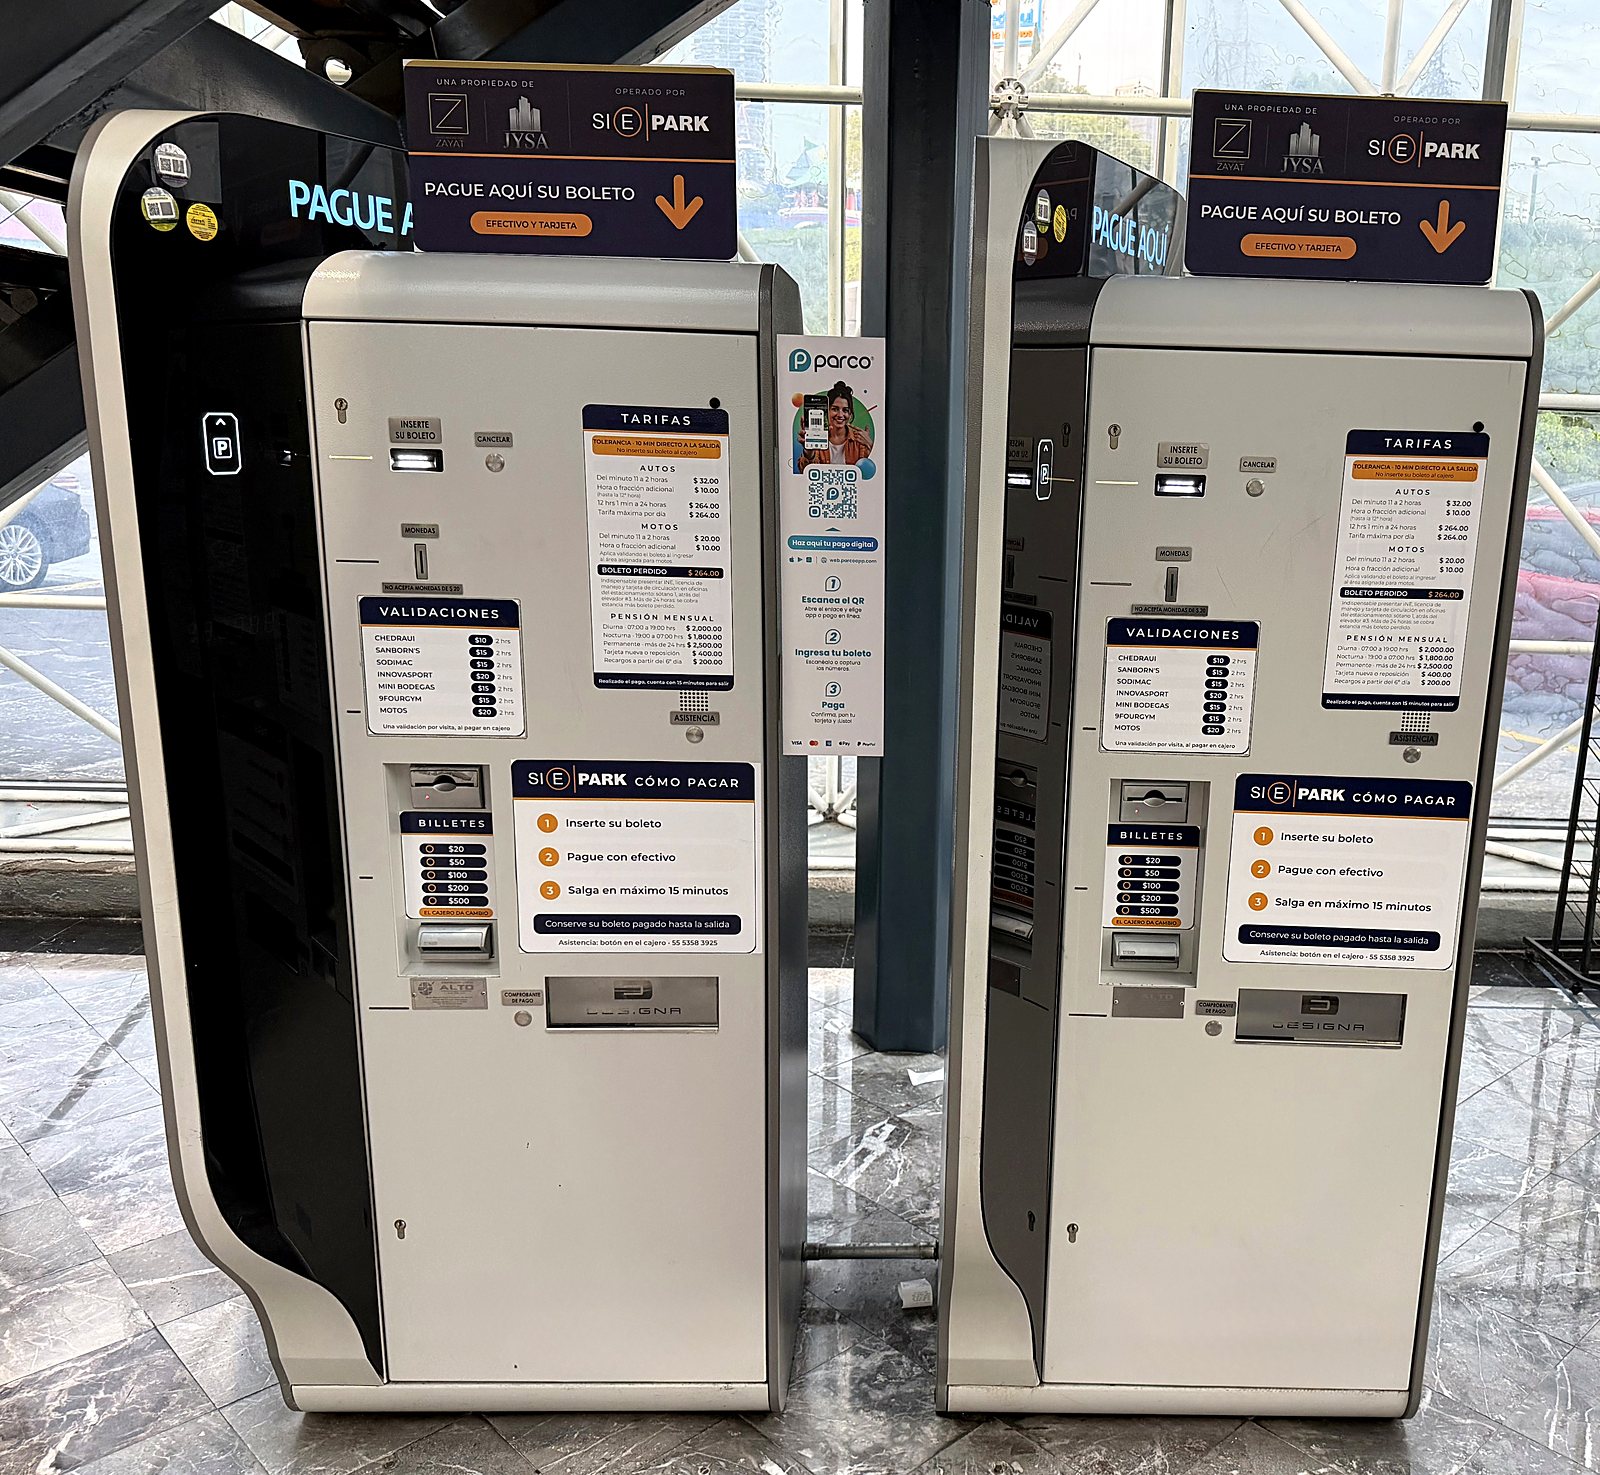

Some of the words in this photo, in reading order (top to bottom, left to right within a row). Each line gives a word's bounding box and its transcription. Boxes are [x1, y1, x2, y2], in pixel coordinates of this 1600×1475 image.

[436, 78, 457, 86] UNA
[461, 79, 517, 88] PROPIEDAD
[615, 88, 662, 96] OPERADO
[1247, 105, 1301, 114] PROPIEDAD
[652, 114, 709, 132] PARK
[1393, 115, 1438, 124] OPERADO
[503, 133, 549, 149] JYSA
[1424, 142, 1481, 160] PARK
[1217, 162, 1244, 171] ZAYAT
[1280, 157, 1324, 174] JYSA
[424, 182, 484, 198] PAGUE
[489, 182, 533, 200] AQUÍ
[537, 185, 560, 198] SU
[565, 186, 635, 200] BOLETO
[288, 179, 394, 234] PAGUE
[1201, 205, 1257, 220] PAGUE
[1261, 205, 1305, 224] AQUÍ
[1308, 208, 1330, 222] SU
[1335, 211, 1401, 225] BOLETO
[486, 219, 528, 229] EFECTIVO
[531, 221, 536, 229] Y
[539, 221, 577, 230] TARJETA
[1092, 205, 1136, 257] PAGUE
[1137, 224, 1169, 270] AQUÍ
[1255, 242, 1296, 251] EFECTIVO
[1305, 244, 1342, 253] TARJETA
[814, 354, 871, 372] parco
[400, 421, 429, 429] INSERTE
[621, 413, 691, 426] TARIFAS
[395, 431, 405, 439] SU
[407, 431, 436, 440] BOLETO
[1384, 438, 1452, 449] TARIFAS
[851, 540, 874, 549] digital
[802, 596, 840, 604] Escanea
[842, 596, 850, 604] el
[379, 607, 499, 618] VALIDACIONES
[1126, 628, 1239, 639] VALIDACIONES
[795, 649, 829, 658] Ingresa
[843, 649, 872, 658] boleto
[822, 701, 845, 710] Paga
[1393, 734, 1434, 742] ASISTENCIA
[578, 773, 627, 786] PARK
[634, 775, 681, 787] CÓMO
[688, 778, 739, 788] PAGAR
[1298, 788, 1346, 801] PARK
[1353, 792, 1398, 804] CÓMO
[1404, 795, 1456, 806] PAGAR
[418, 819, 485, 828] BILLETES
[566, 819, 606, 828] Inserte
[625, 818, 662, 829] boleto
[1120, 832, 1183, 841] BILLETES
[1280, 832, 1319, 842] Inserte
[1338, 834, 1374, 844] boleto
[545, 853, 553, 862] 2
[567, 853, 604, 863] Pague
[630, 852, 676, 862] efectivo
[1257, 865, 1264, 873] 2
[1278, 865, 1313, 876] Pague
[1316, 868, 1336, 876] con
[1339, 867, 1384, 878] efectivo
[546, 886, 554, 895] 3
[568, 886, 599, 897] Salga
[620, 885, 666, 895] máximo
[669, 886, 680, 895] 15
[682, 886, 729, 896] minutos
[1254, 898, 1262, 906] 3
[1275, 898, 1305, 908] Salga
[1325, 899, 1370, 910] máximo
[1372, 901, 1383, 910] 15
[1386, 902, 1432, 912] minutos
[545, 920, 587, 928] Conserve
[601, 920, 630, 928] boleto
[632, 920, 666, 930] pagado
[668, 920, 693, 929] hasta
[695, 920, 702, 928] la
[704, 920, 730, 929] salida
